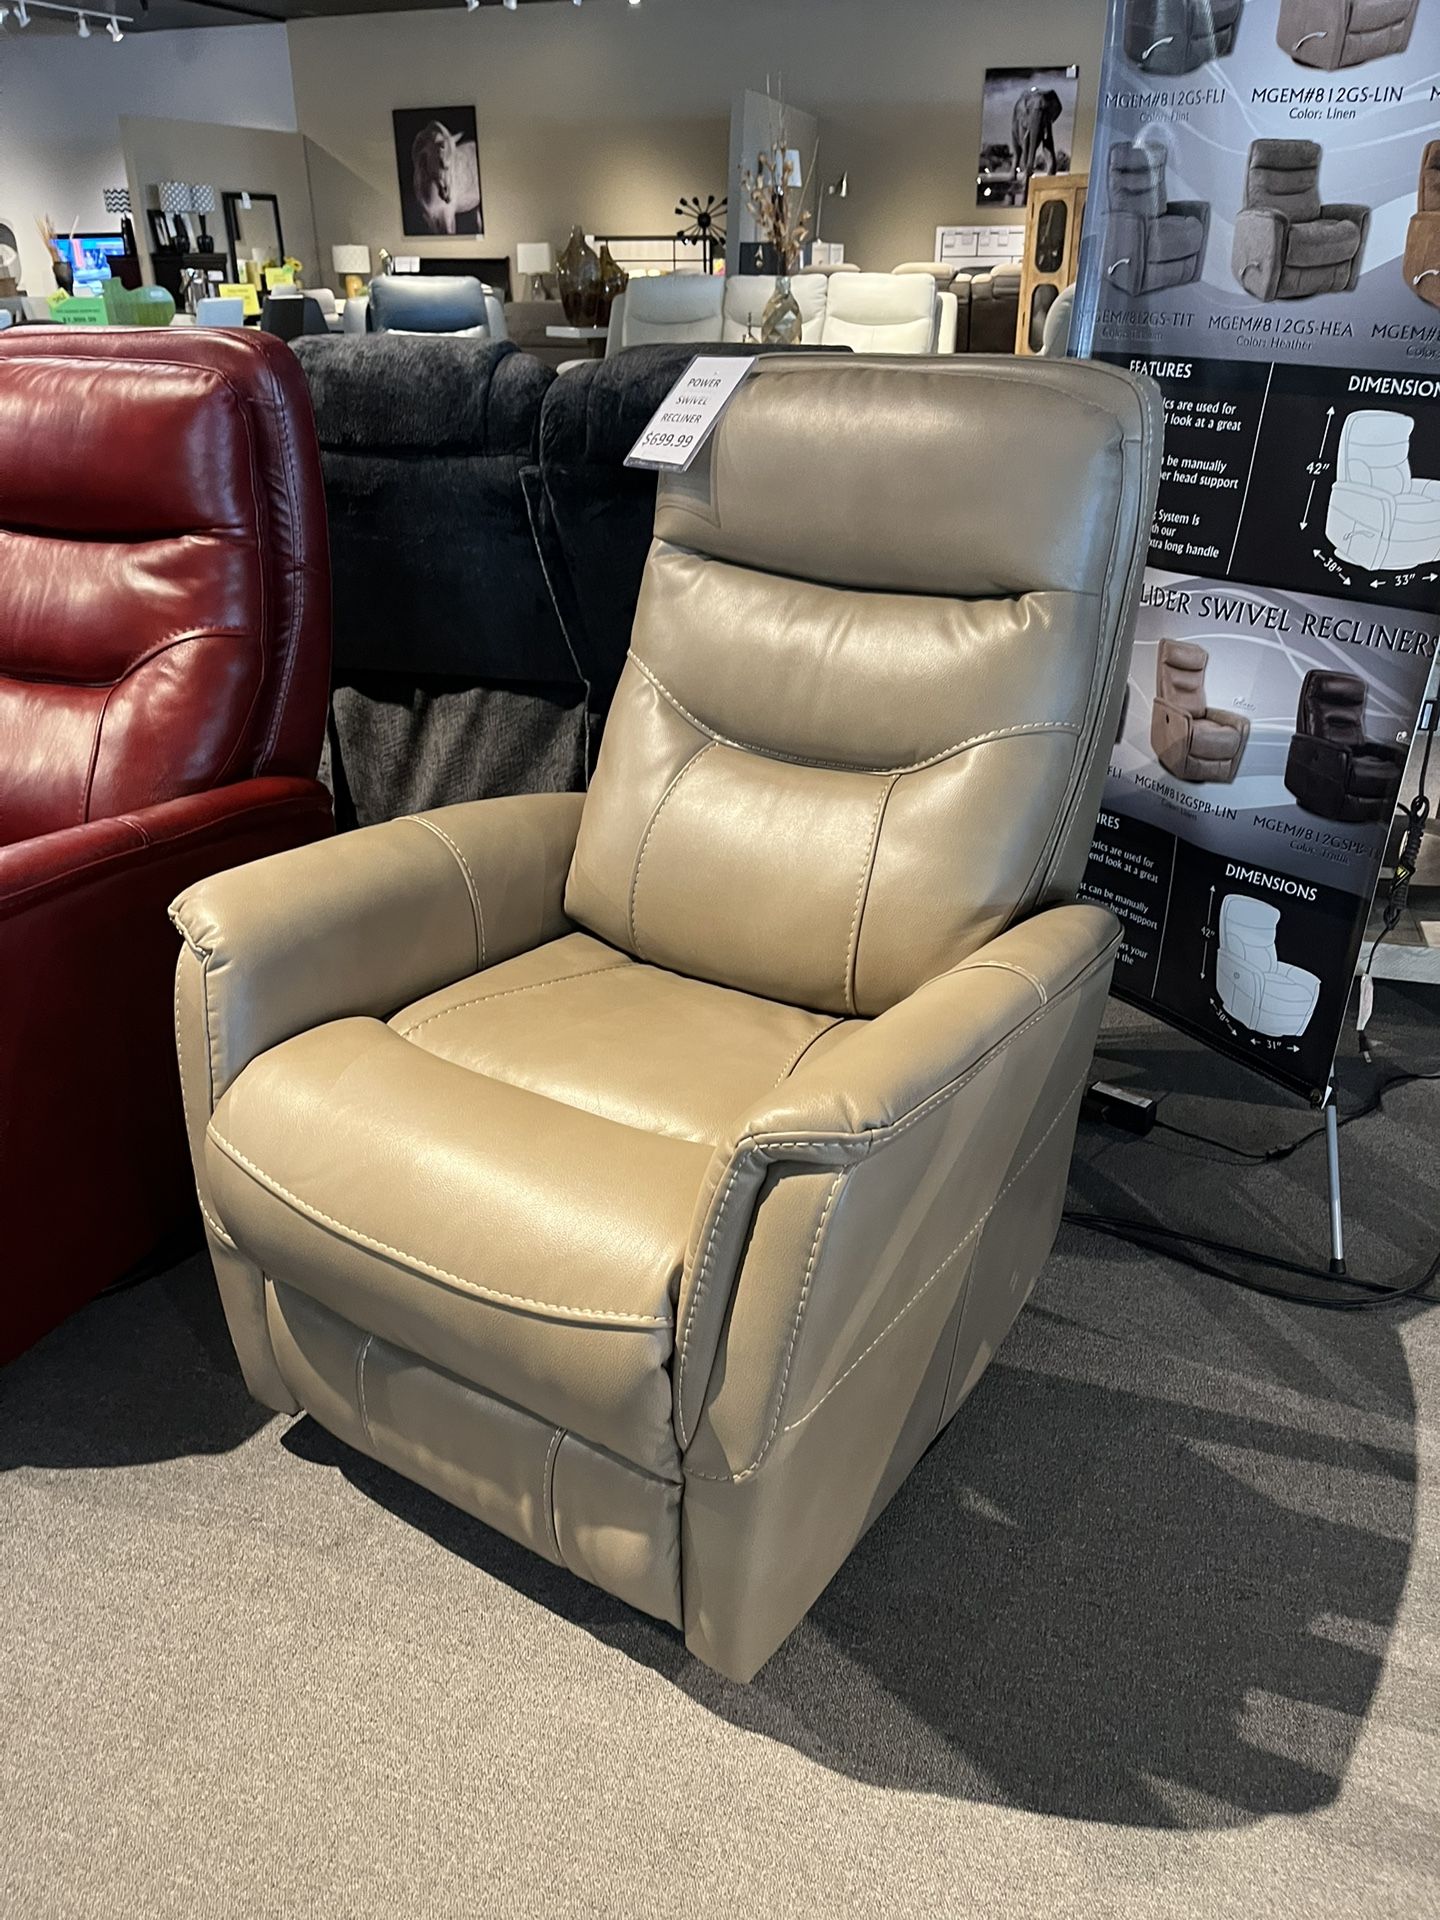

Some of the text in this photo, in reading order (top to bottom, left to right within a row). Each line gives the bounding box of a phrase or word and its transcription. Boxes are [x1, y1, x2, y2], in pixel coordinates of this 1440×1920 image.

[1251, 86, 1404, 104] MGEM#812GS-LIN
[1326, 107, 1356, 120] Linen
[1208, 315, 1353, 338] MGEM#812GS-HEA
[1270, 336, 1313, 350] Heather
[687, 378, 721, 388] POWER
[675, 396, 707, 405] SWIVEL
[1176, 400, 1194, 412] are
[1195, 402, 1220, 413] used
[1221, 401, 1237, 415] for
[660, 413, 702, 423] RECLINER
[1170, 412, 1192, 427] look
[1194, 417, 1206, 428] at
[1216, 419, 1242, 432] great
[642, 431, 694, 448] $699.99
[1166, 454, 1179, 467] be
[1181, 458, 1227, 474] manually
[1172, 470, 1198, 484] head
[1199, 475, 1239, 489] support
[1158, 508, 1190, 525] System
[1160, 526, 1177, 538] our
[1164, 539, 1184, 555] long
[1185, 542, 1220, 559] handle
[1141, 583, 1191, 615] LIDER
[1198, 597, 1292, 632] SWIVEL
[1109, 847, 1123, 857] are
[1123, 850, 1142, 864] used
[1142, 856, 1155, 869] for
[1105, 855, 1123, 870] look
[1139, 869, 1159, 884] great
[1225, 863, 1318, 902] DIMENSIONS
[1088, 884, 1103, 896] can
[1103, 888, 1114, 900] be
[1115, 894, 1149, 915] manually
[1110, 902, 1158, 931] head support
[1121, 953, 1135, 966] the
[1130, 945, 1149, 960] your
